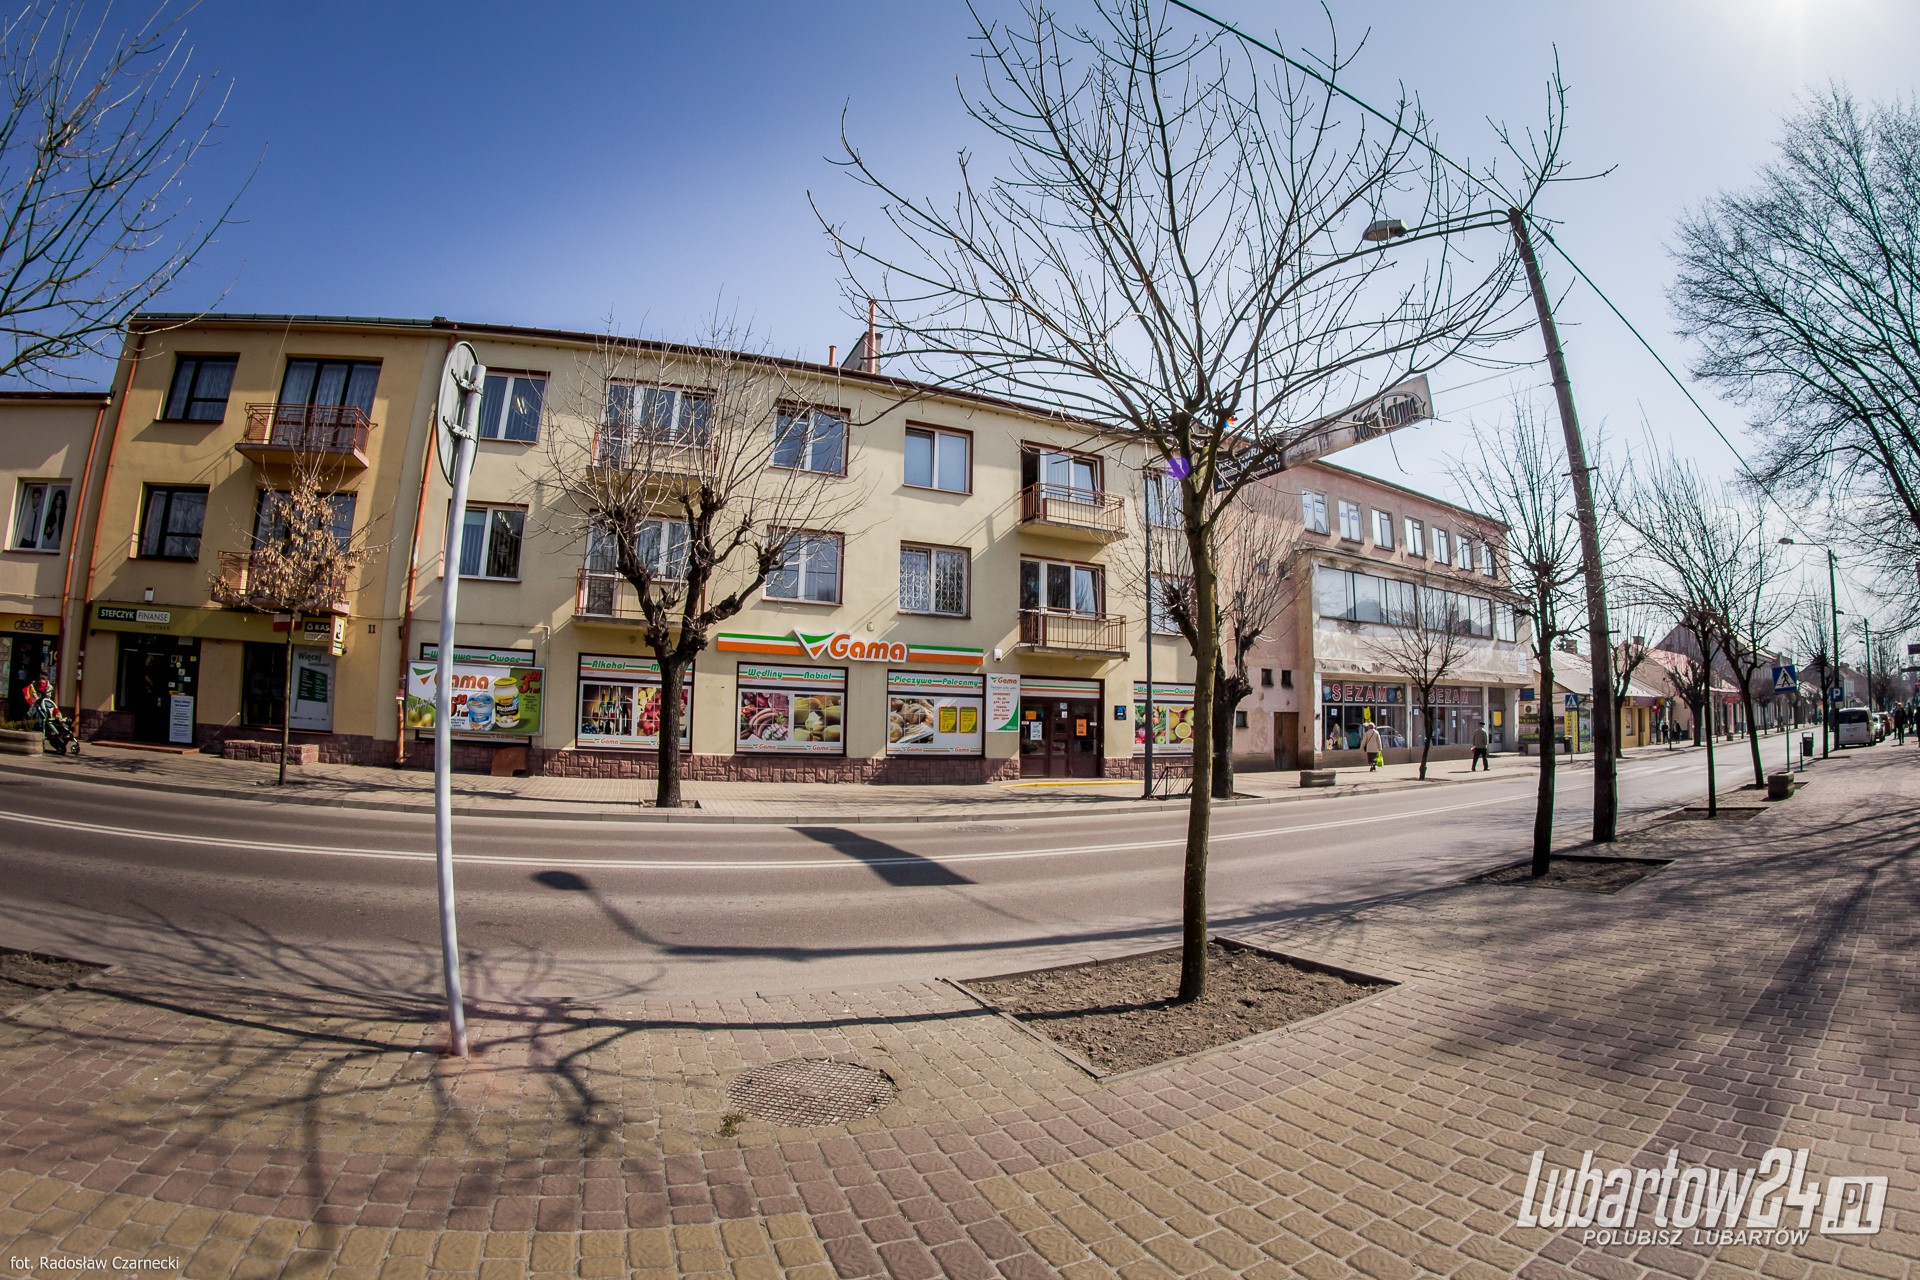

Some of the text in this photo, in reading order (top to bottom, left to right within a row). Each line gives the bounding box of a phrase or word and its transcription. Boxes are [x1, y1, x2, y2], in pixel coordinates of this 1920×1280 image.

[1273, 462, 1281, 470] 17
[101, 608, 169, 622] STEFCZYK FINANSE
[314, 624, 330, 632] KAS
[367, 624, 376, 634] 11
[829, 633, 906, 661] Gama
[298, 651, 322, 663] Więcej
[489, 654, 521, 663] Owoce
[591, 660, 627, 670] Alkohol
[747, 668, 783, 680] Wędliny
[434, 674, 489, 690] ama
[894, 675, 979, 688] Pieczywo Polecamy
[998, 676, 1018, 685] Gama
[1332, 684, 1387, 702] SEZAM
[1428, 688, 1469, 704] SEZAM
